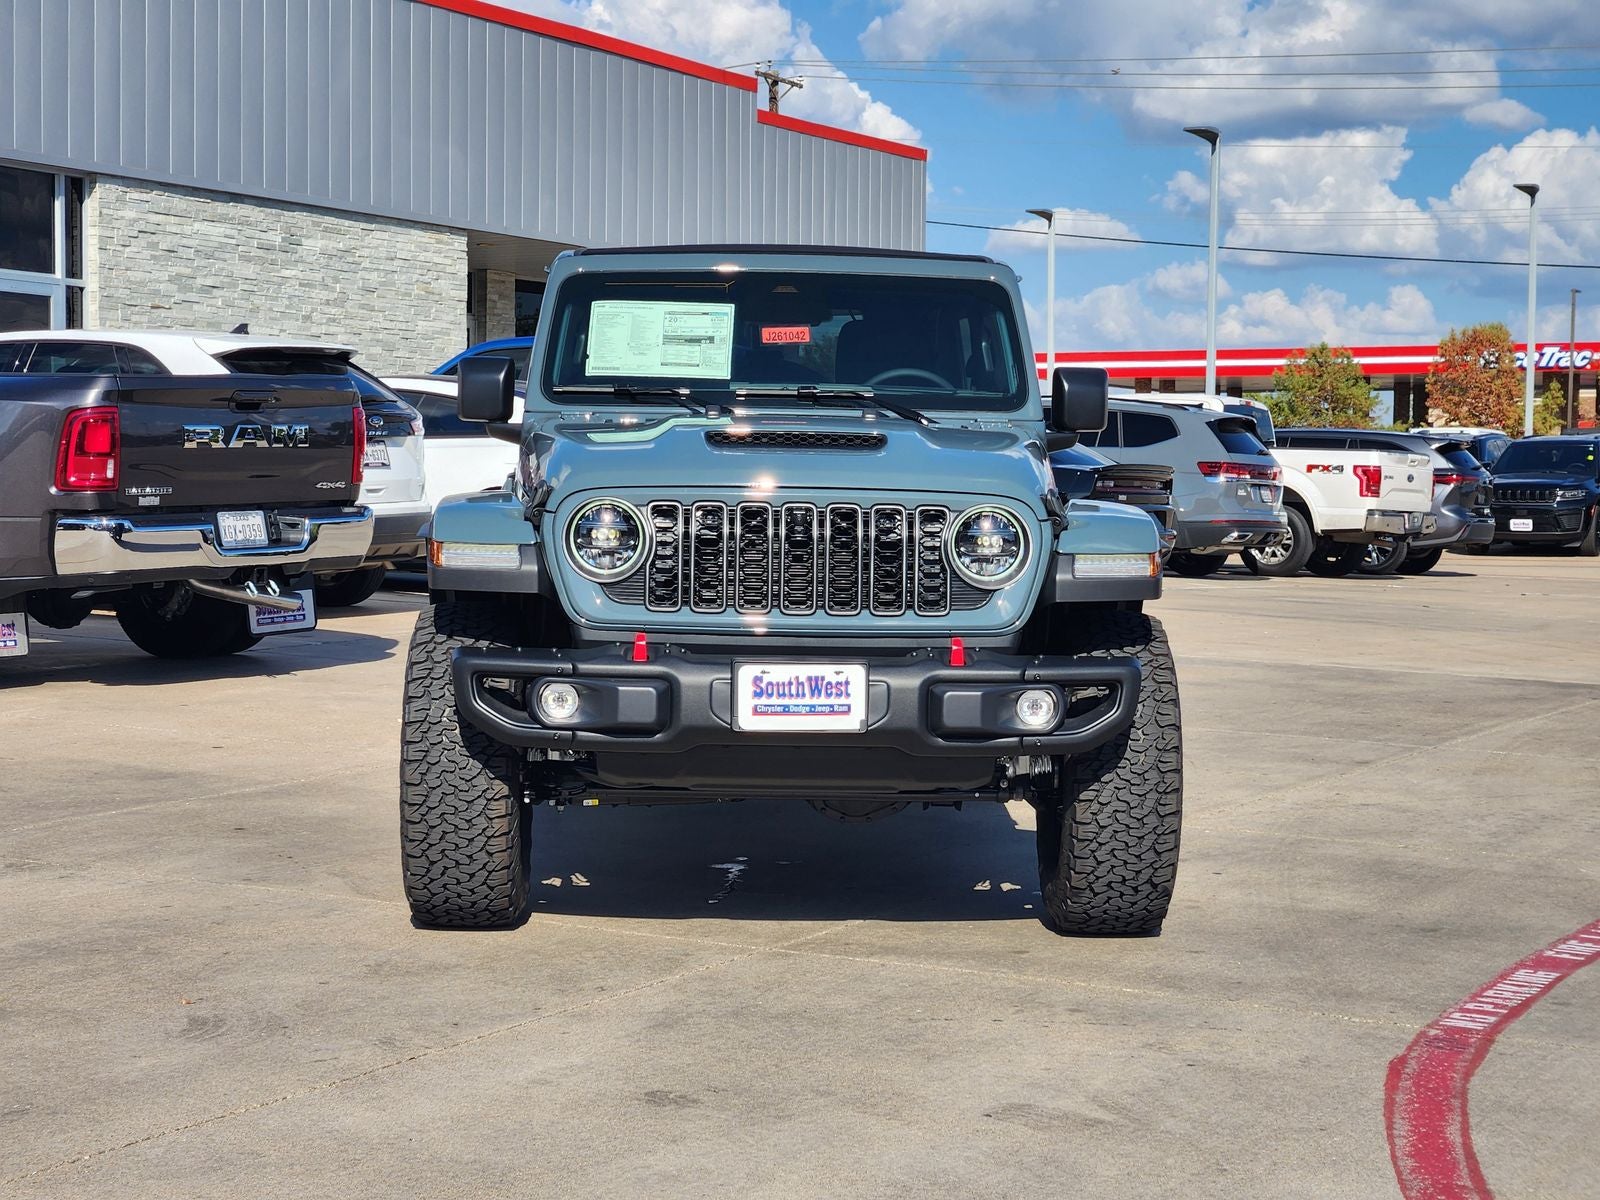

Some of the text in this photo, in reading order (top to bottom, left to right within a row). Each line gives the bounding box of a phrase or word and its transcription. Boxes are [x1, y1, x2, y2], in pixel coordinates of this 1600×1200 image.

[766, 331, 806, 341] J261042
[1512, 346, 1593, 369] ceTrac
[182, 424, 310, 448] RAM
[1306, 464, 1345, 474] FX4
[232, 514, 250, 522] TEXAS
[752, 675, 851, 700] SouthWest
[756, 704, 849, 713] Chrysler Dodge Jeep Ram
[1462, 969, 1563, 1013] PARKING
[1439, 1012, 1499, 1030] NO
